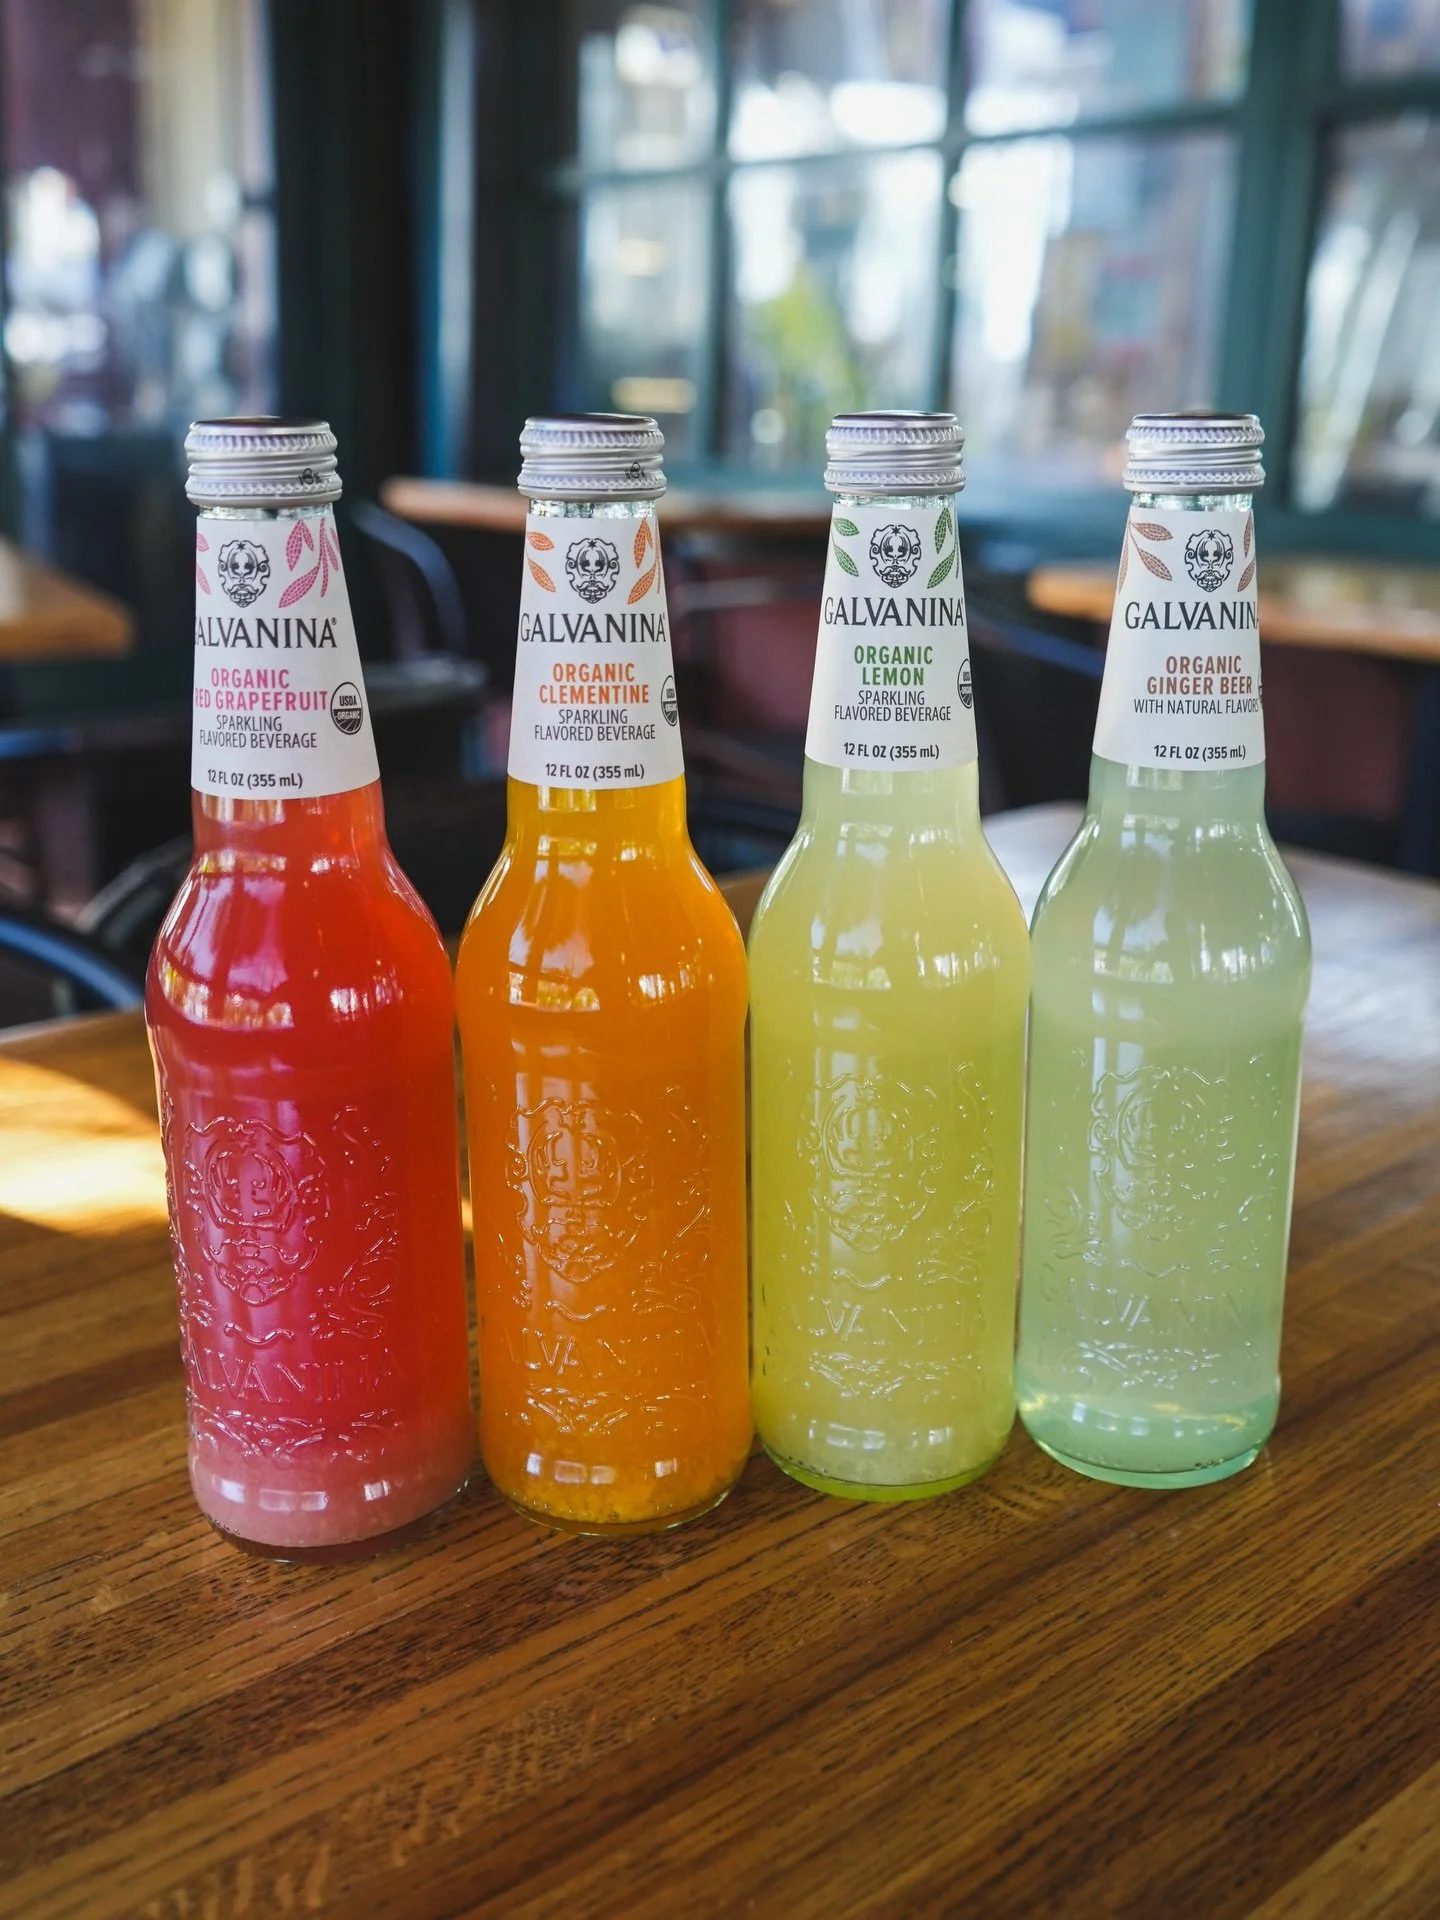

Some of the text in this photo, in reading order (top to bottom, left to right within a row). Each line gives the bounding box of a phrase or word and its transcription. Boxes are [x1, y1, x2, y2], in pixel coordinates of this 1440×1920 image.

[1125, 601, 1259, 630] GALVANIN
[195, 617, 337, 648] ALVANINA
[854, 645, 933, 665] ORGANIC
[553, 663, 635, 682] ORGANIC
[1166, 655, 1242, 674] ORGANIC
[211, 667, 290, 689] ORGANIC
[862, 667, 924, 685] LEMON
[539, 684, 649, 704] CLEMENTINE
[1147, 676, 1252, 695] GINGER BEER
[215, 690, 328, 711] GRAPEFRUIT
[339, 695, 357, 707] USDA
[858, 690, 925, 706] SPARKLING
[1133, 698, 1163, 714] WITH
[1167, 699, 1222, 715] NATURAL
[558, 709, 628, 725] SPARKLING
[834, 705, 951, 721] FLAVORED BEVERAGE
[216, 714, 282, 731] SPARKLING
[199, 730, 317, 748] FLAVORED BEVERAGE
[534, 724, 656, 741] FLAVORED BEVERAGE
[843, 742, 939, 761] 12 FL OZ (355 mL)
[1154, 745, 1246, 762] 12 FL OZ (355 mL)
[207, 769, 303, 789] 12 FL OZ (355 mL)
[545, 763, 644, 781] 12 FL OZ (355 mL)
